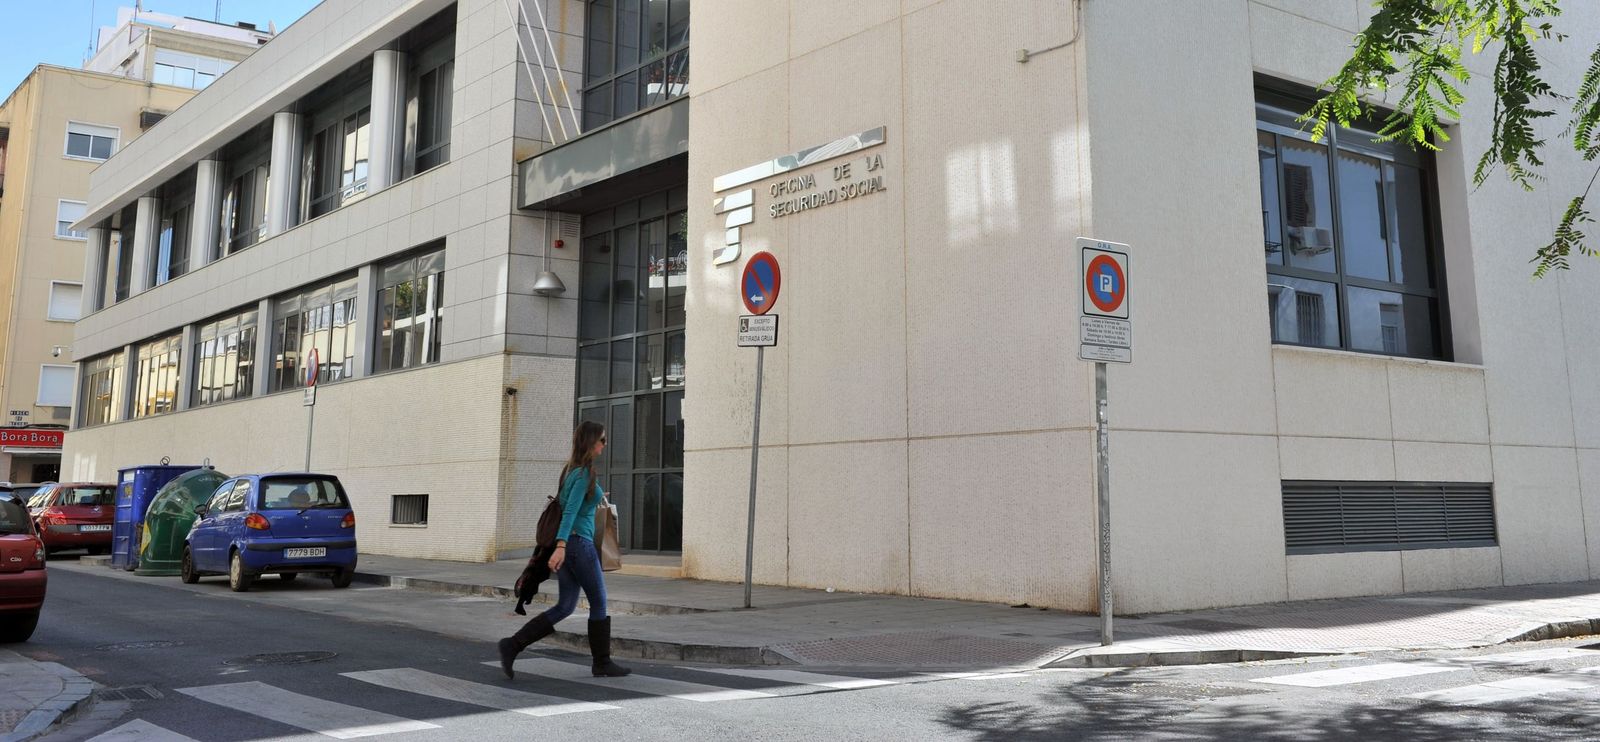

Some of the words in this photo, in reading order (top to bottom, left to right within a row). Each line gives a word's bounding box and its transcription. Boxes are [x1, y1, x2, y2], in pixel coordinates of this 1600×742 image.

[769, 174, 816, 198] OFICINA
[833, 163, 852, 181] DE
[867, 154, 884, 172] LA
[769, 189, 838, 219] SEGURIDAD
[839, 176, 887, 201] SOCIAL
[1102, 276, 1110, 290] P
[1, 431, 28, 441] Bora
[31, 432, 58, 442] Bora
[288, 548, 308, 557] 7779
[309, 547, 325, 556] BDH
